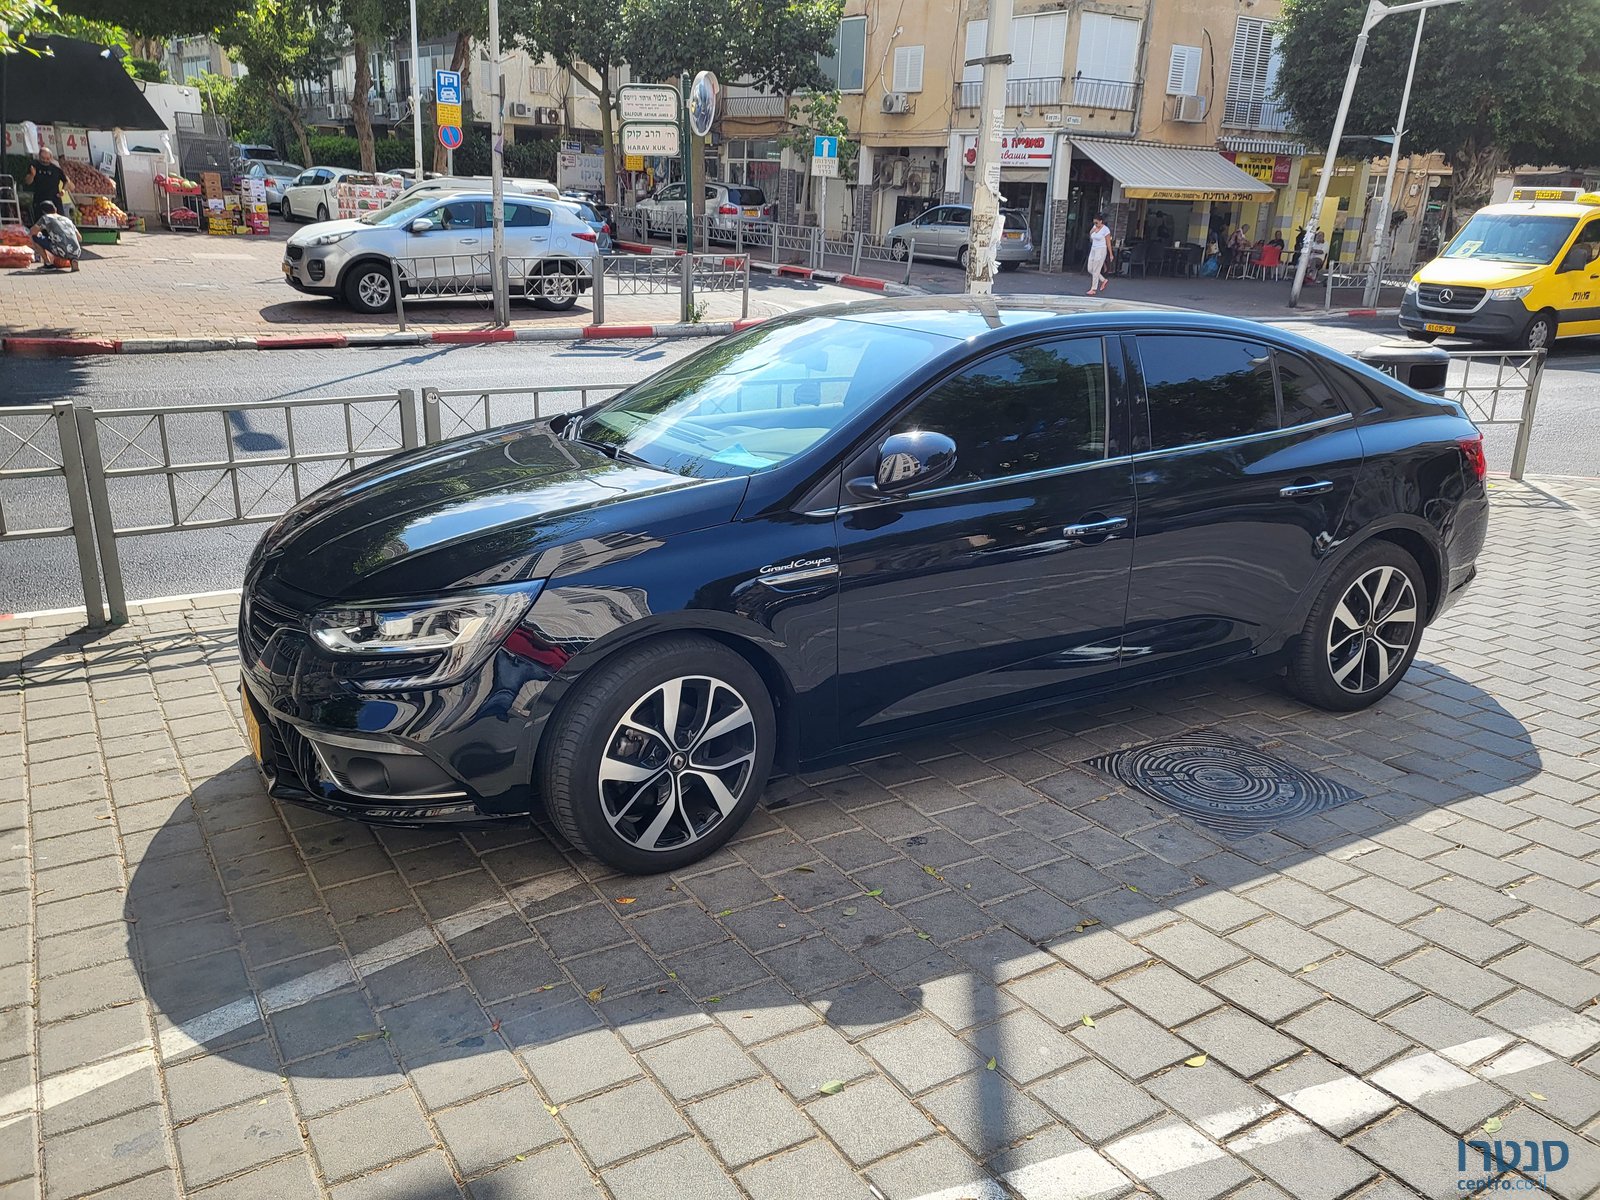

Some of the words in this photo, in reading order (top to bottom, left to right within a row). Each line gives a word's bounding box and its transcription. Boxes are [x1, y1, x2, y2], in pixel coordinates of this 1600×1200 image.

[626, 130, 642, 140] קוק
[645, 130, 660, 138] הרב
[760, 560, 794, 574] Grand
